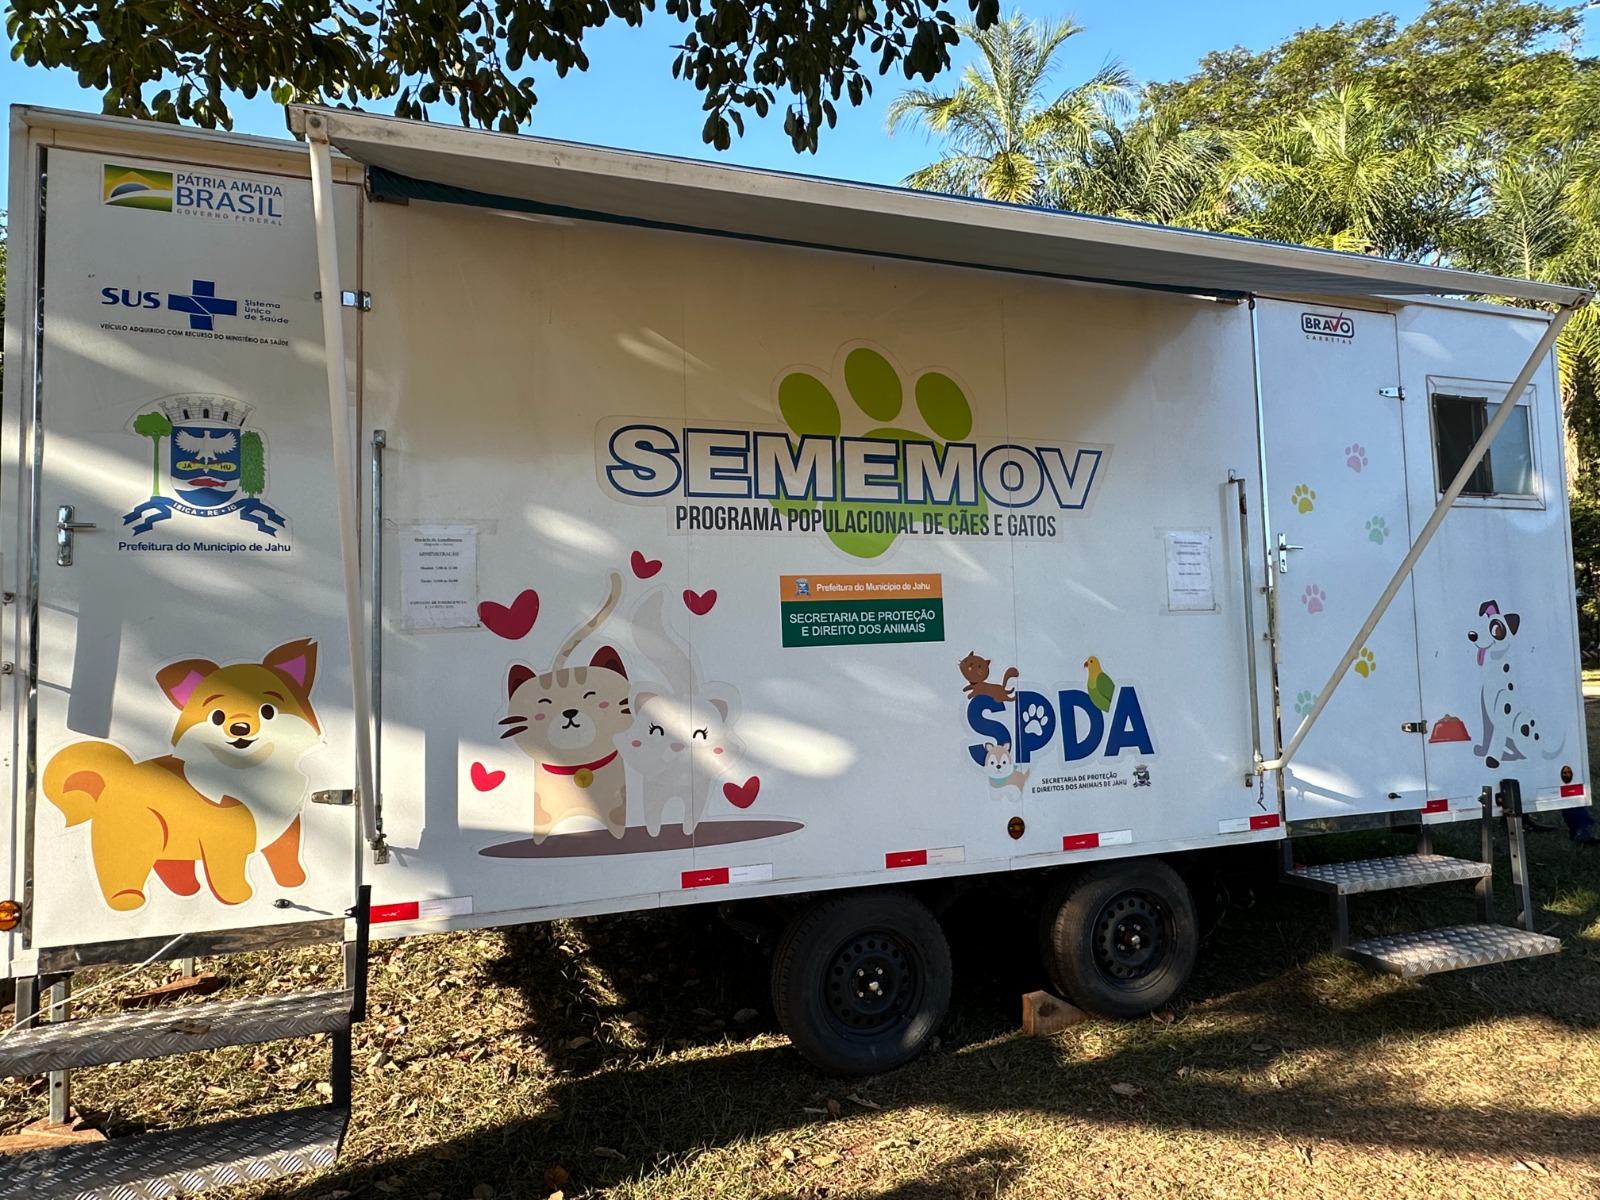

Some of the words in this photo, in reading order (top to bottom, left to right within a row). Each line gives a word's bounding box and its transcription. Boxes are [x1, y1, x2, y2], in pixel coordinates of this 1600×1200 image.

[177, 172, 226, 190] PÁTRIA
[230, 181, 282, 196] AMADA
[176, 186, 282, 218] BRASIL
[176, 208, 229, 219] GOVERNO
[236, 215, 282, 226] FEDERAL
[101, 287, 160, 309] SUS
[244, 300, 280, 308] Sistema
[259, 315, 289, 324] Saúde
[1304, 313, 1350, 333] BRAVO
[100, 323, 128, 331] VEÍCULO
[1306, 334, 1352, 344] CARRETAS
[605, 424, 1103, 509] SEMEMOV
[676, 505, 782, 531] PROGRAMA
[787, 508, 918, 534] POPULACIONAL
[923, 512, 944, 535] DE
[948, 509, 989, 536] CÃES
[994, 514, 1003, 536] E
[1007, 514, 1056, 537] GATOS
[118, 542, 173, 552] Prefeitura
[176, 542, 191, 552] do
[249, 543, 262, 552] de
[265, 543, 291, 552] Jahu
[816, 583, 852, 592] Prefeitura
[854, 583, 864, 591] do
[902, 582, 911, 590] de
[912, 582, 930, 590] Jahu
[790, 612, 859, 623] SECRETARIA
[861, 612, 875, 621] DE
[878, 609, 935, 622] PROTEÇÃO
[802, 626, 809, 636] E
[812, 625, 856, 636] DIREITO
[858, 624, 881, 634] DOS
[883, 623, 926, 634] ANIMAIS
[966, 686, 1154, 767] SPDA
[1042, 775, 1077, 784] SECRETARIA
[1087, 771, 1117, 781] PROTEÇÃO
[1037, 784, 1064, 793] DIREITOS
[1065, 783, 1078, 791] DOS
[1079, 781, 1102, 789] ANIMAIS
